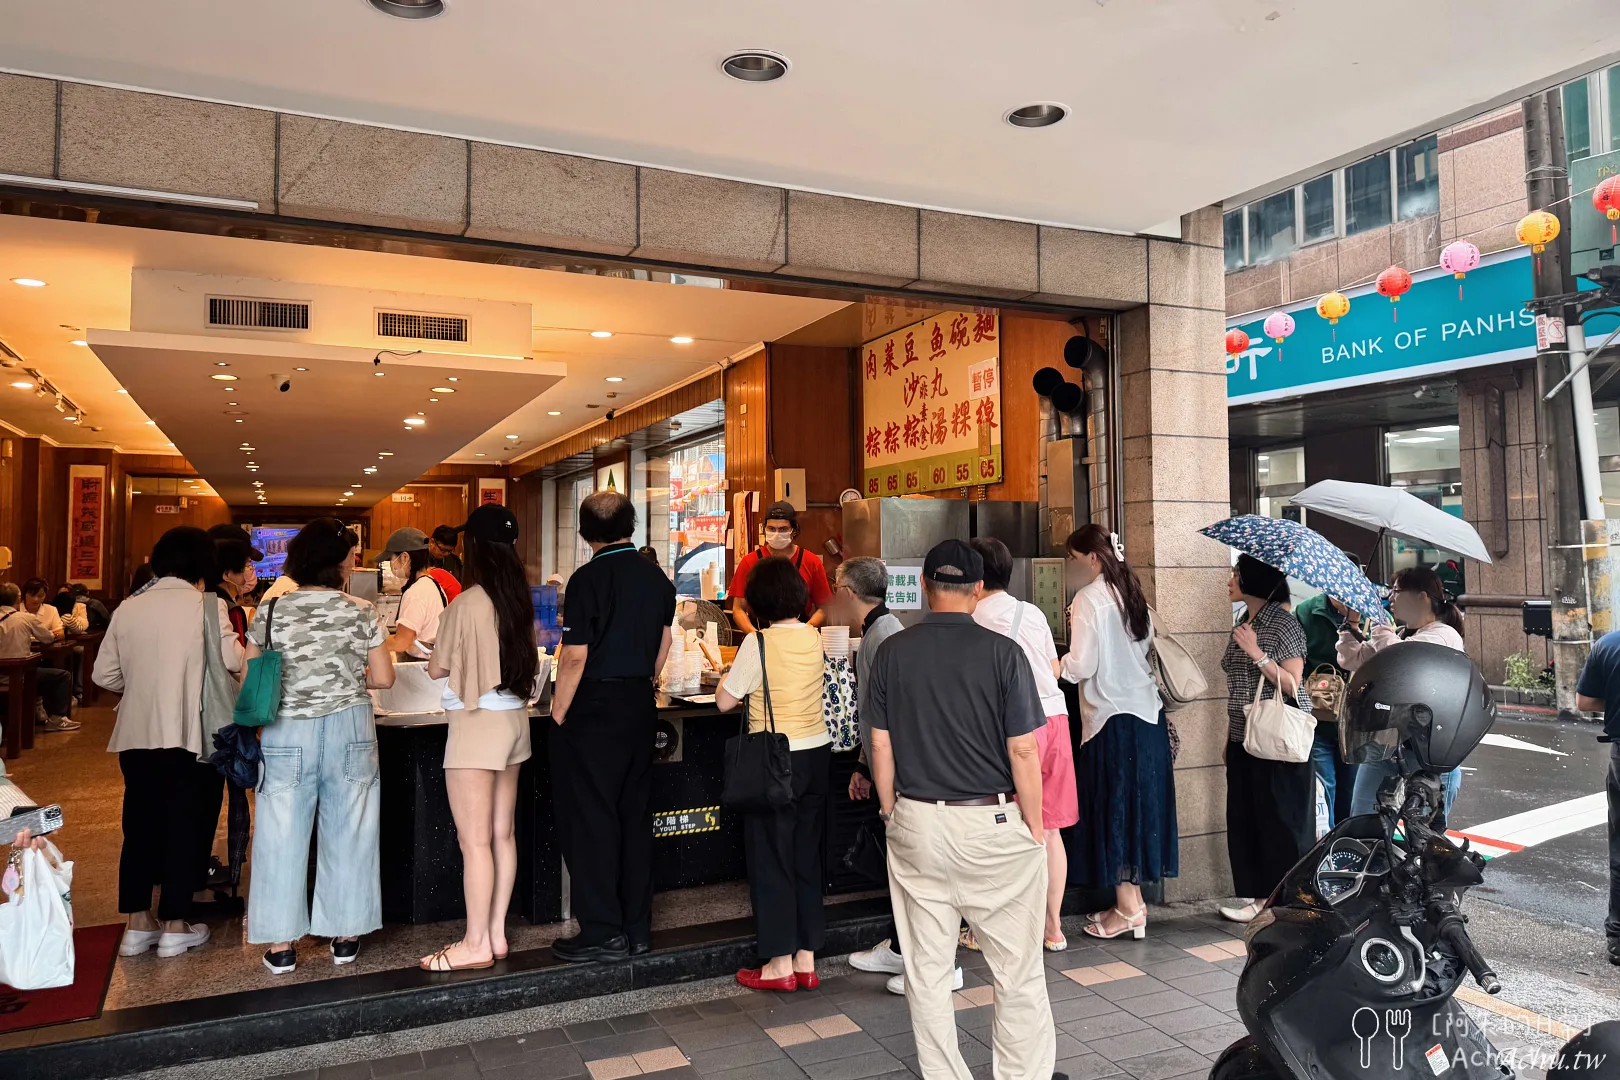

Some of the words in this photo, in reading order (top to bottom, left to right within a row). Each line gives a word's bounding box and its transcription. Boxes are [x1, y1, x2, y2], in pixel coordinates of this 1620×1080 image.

[1321, 336, 1384, 364] BANK
[1394, 326, 1428, 350] OF
[1441, 307, 1536, 342] PANHS
[928, 321, 949, 446] 魚丸湯
[949, 313, 972, 439] 碗粿
[971, 367, 995, 393] 暫停
[883, 339, 900, 455] 菜粽
[902, 331, 921, 449] 豆沙粽
[865, 349, 881, 459] 肉粽
[906, 471, 918, 489] 65
[932, 466, 946, 485] 60
[956, 463, 970, 481] 55
[868, 477, 879, 494] 85
[887, 474, 898, 491] 65
[886, 591, 917, 604] 先告知
[653, 814, 689, 827] 心階梯
[659, 825, 677, 833] YOUR
